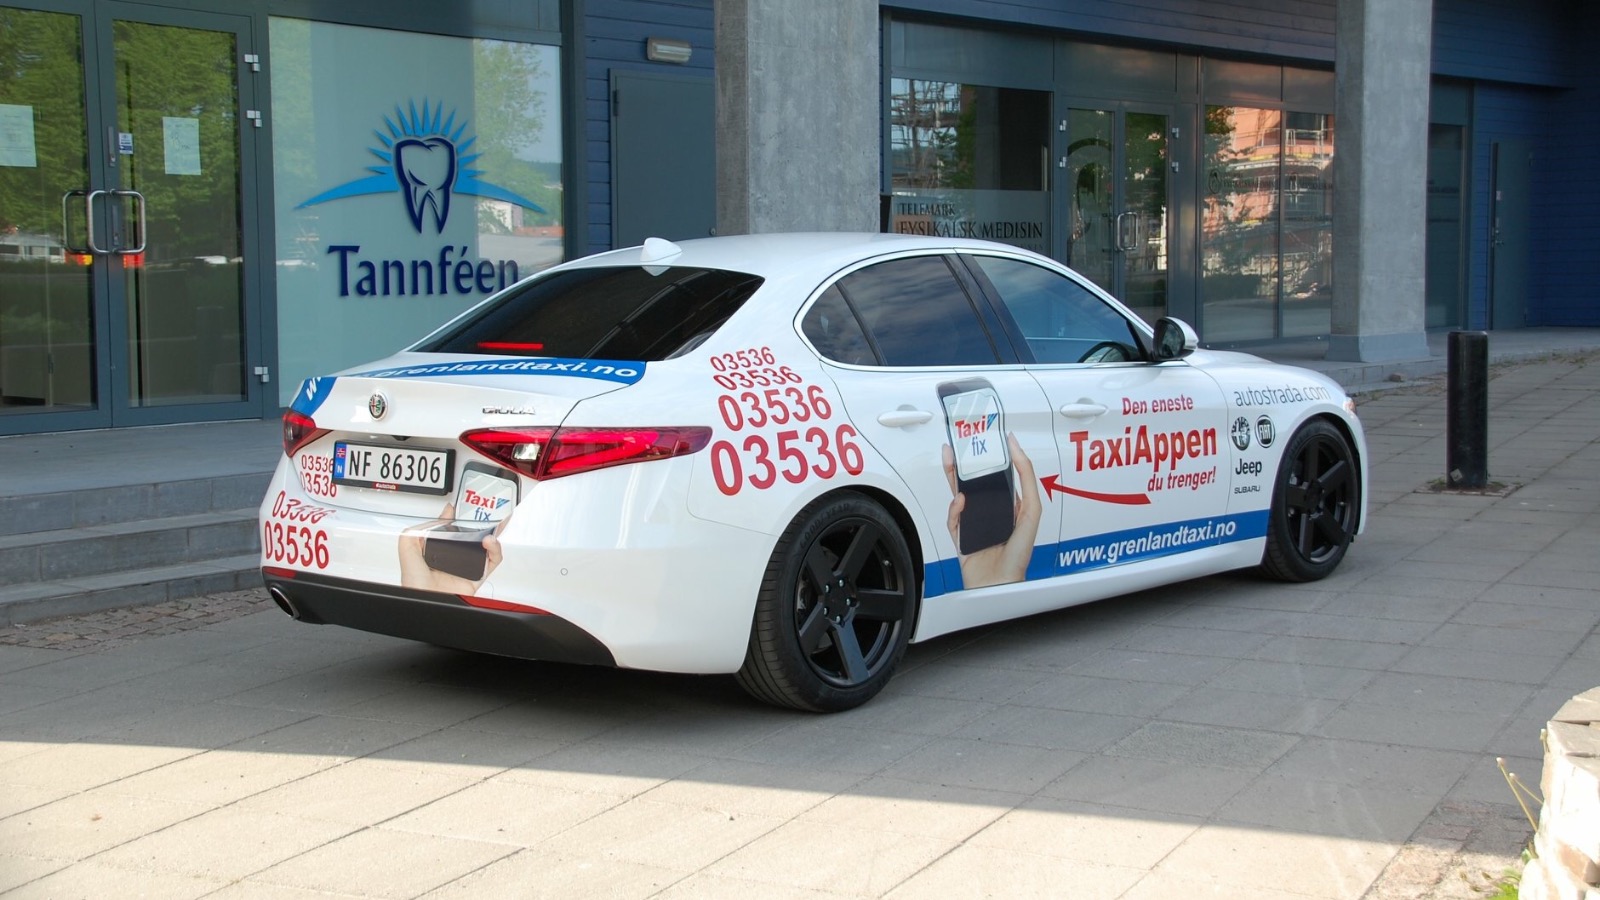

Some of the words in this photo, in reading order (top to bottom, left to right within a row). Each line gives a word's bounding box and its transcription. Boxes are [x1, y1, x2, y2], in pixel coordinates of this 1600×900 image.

[981, 222, 1043, 238] MEDISIN
[327, 245, 519, 296] Tannféen
[710, 346, 775, 372] 03536
[713, 366, 802, 390] 03536
[1122, 397, 1147, 416] Den
[1151, 394, 1193, 413] eneste
[1233, 384, 1331, 407] autostrada.com
[717, 385, 832, 431] 03536
[955, 415, 987, 439] Taxi
[971, 437, 987, 456] fix
[1069, 425, 1217, 472] TaxiAppen
[348, 450, 372, 477] NF
[380, 452, 441, 484] 86306
[710, 424, 864, 496] 03536
[1235, 458, 1262, 477] Jeep
[1147, 473, 1163, 492] du
[1167, 466, 1216, 488] trenger!
[1234, 485, 1260, 494] SUBARU
[465, 489, 496, 509] Taxi
[474, 507, 491, 521] fix
[264, 520, 329, 569] 03536
[1059, 519, 1236, 567] www.grenlandtaxi.no
